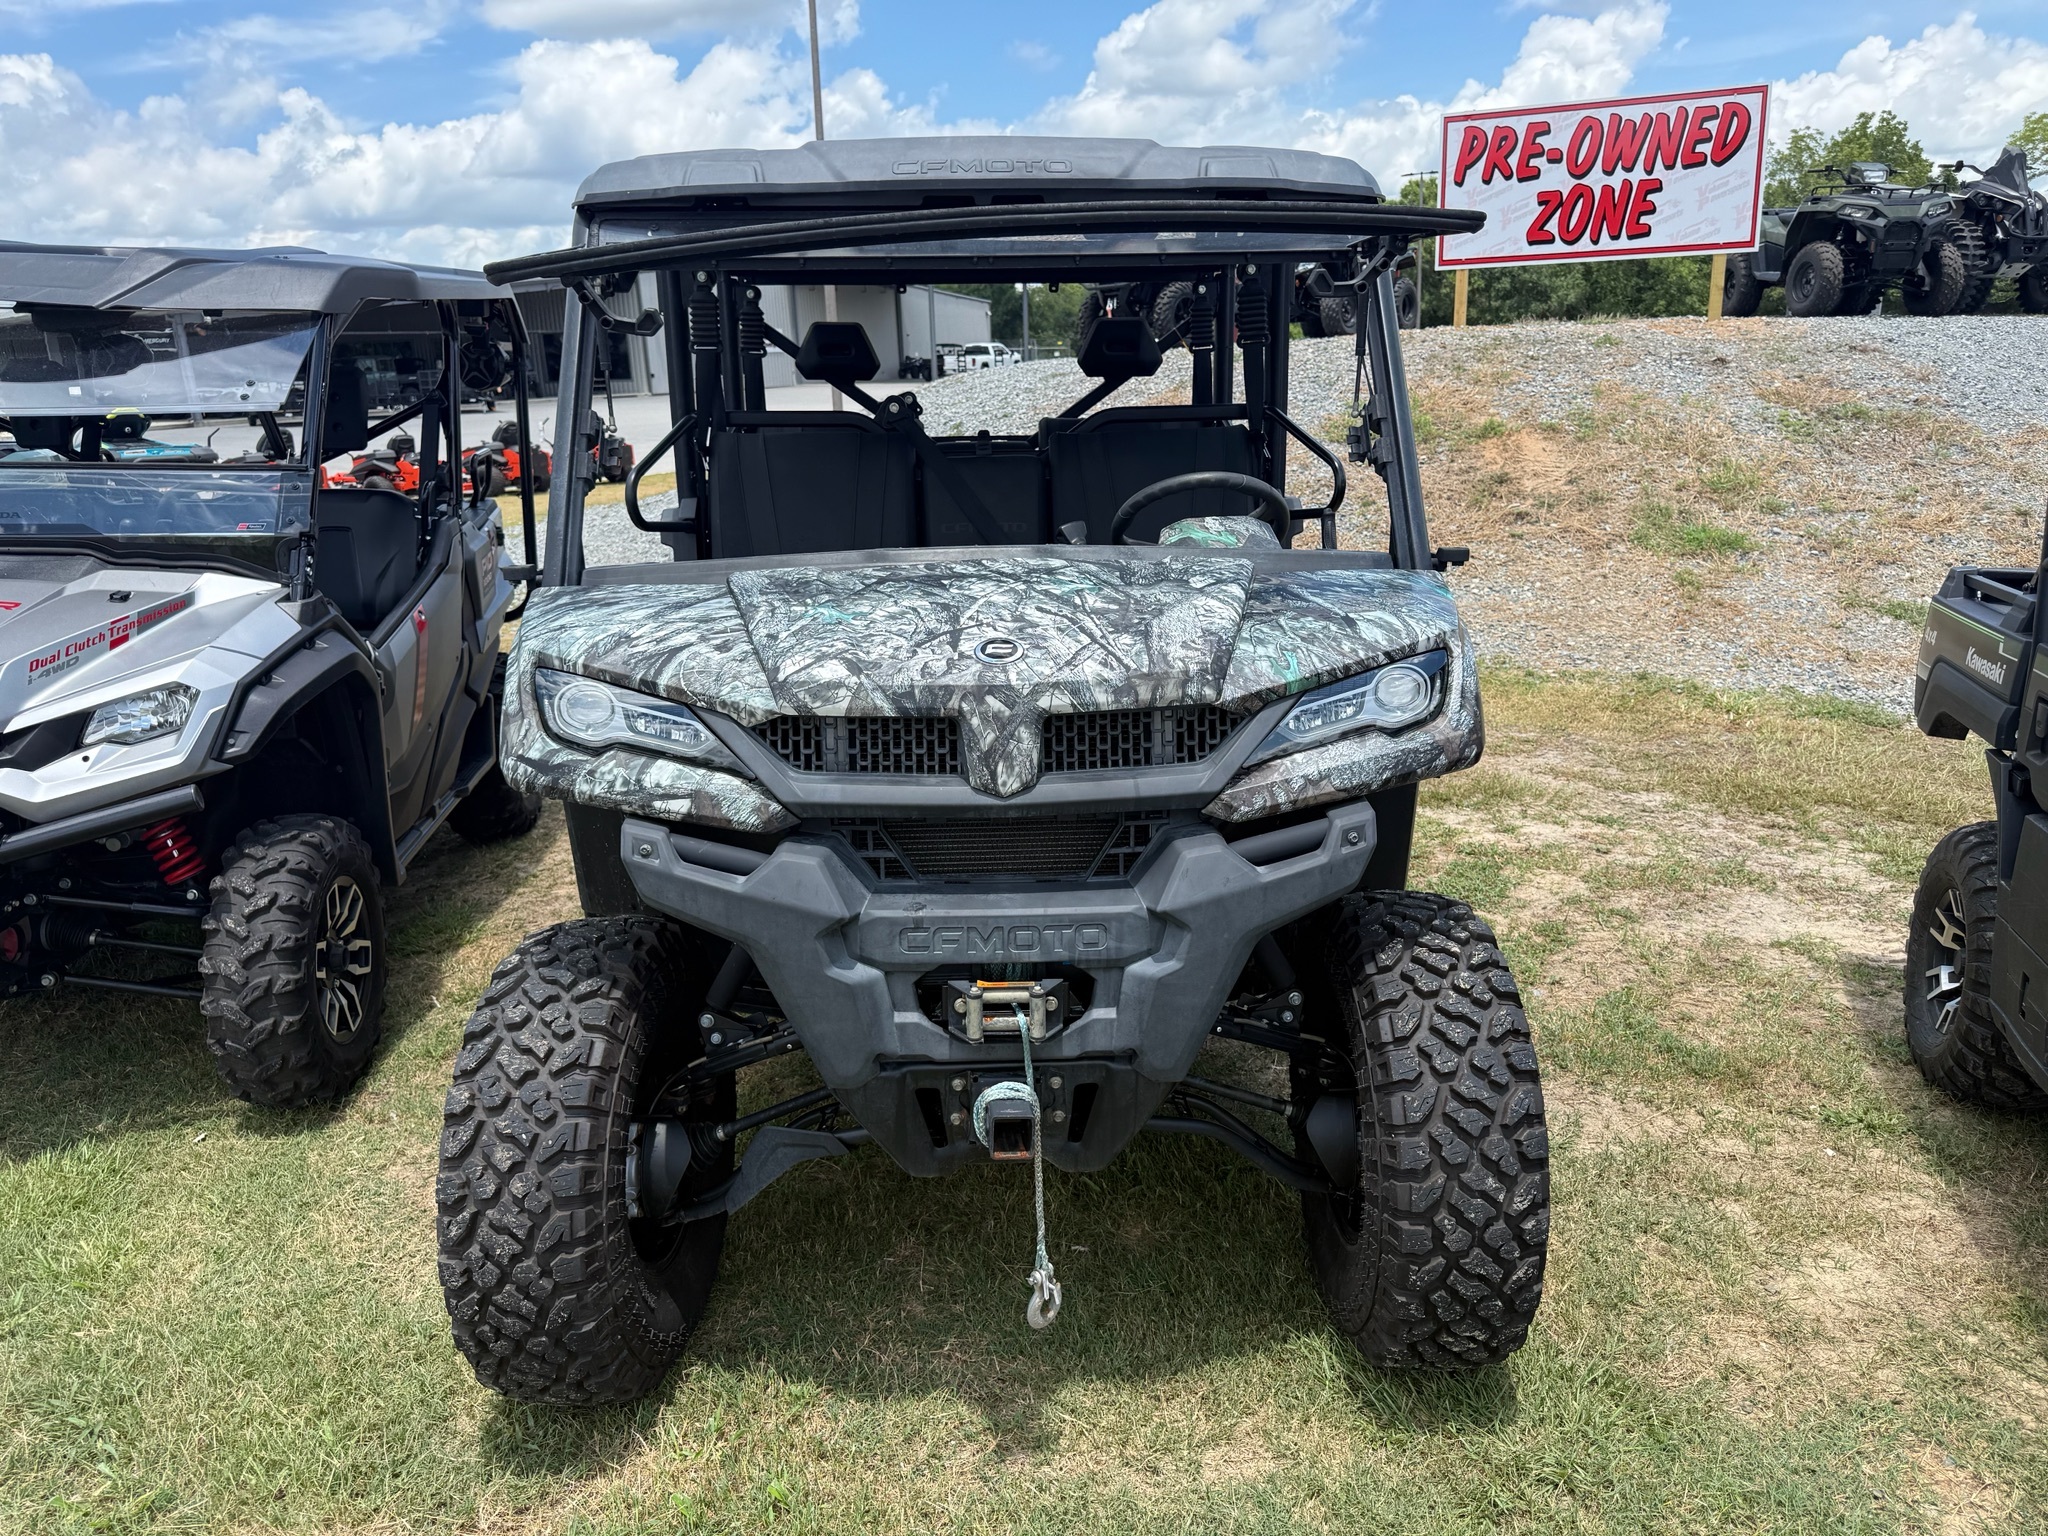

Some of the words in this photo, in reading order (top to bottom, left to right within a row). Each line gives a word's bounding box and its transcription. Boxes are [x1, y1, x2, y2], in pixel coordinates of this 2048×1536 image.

[1454, 102, 1751, 188] PRE-OWNED
[891, 158, 1073, 175] CFMOTO
[1526, 178, 1663, 246] ZONE
[940, 521, 1027, 534] CFTO
[29, 649, 61, 673] Dual
[65, 631, 106, 657] Clutch
[108, 599, 187, 639] Transmission
[27, 655, 80, 686] i-4WD
[1965, 646, 2007, 685] Kawasaki
[899, 922, 1108, 954] CFMOTO
